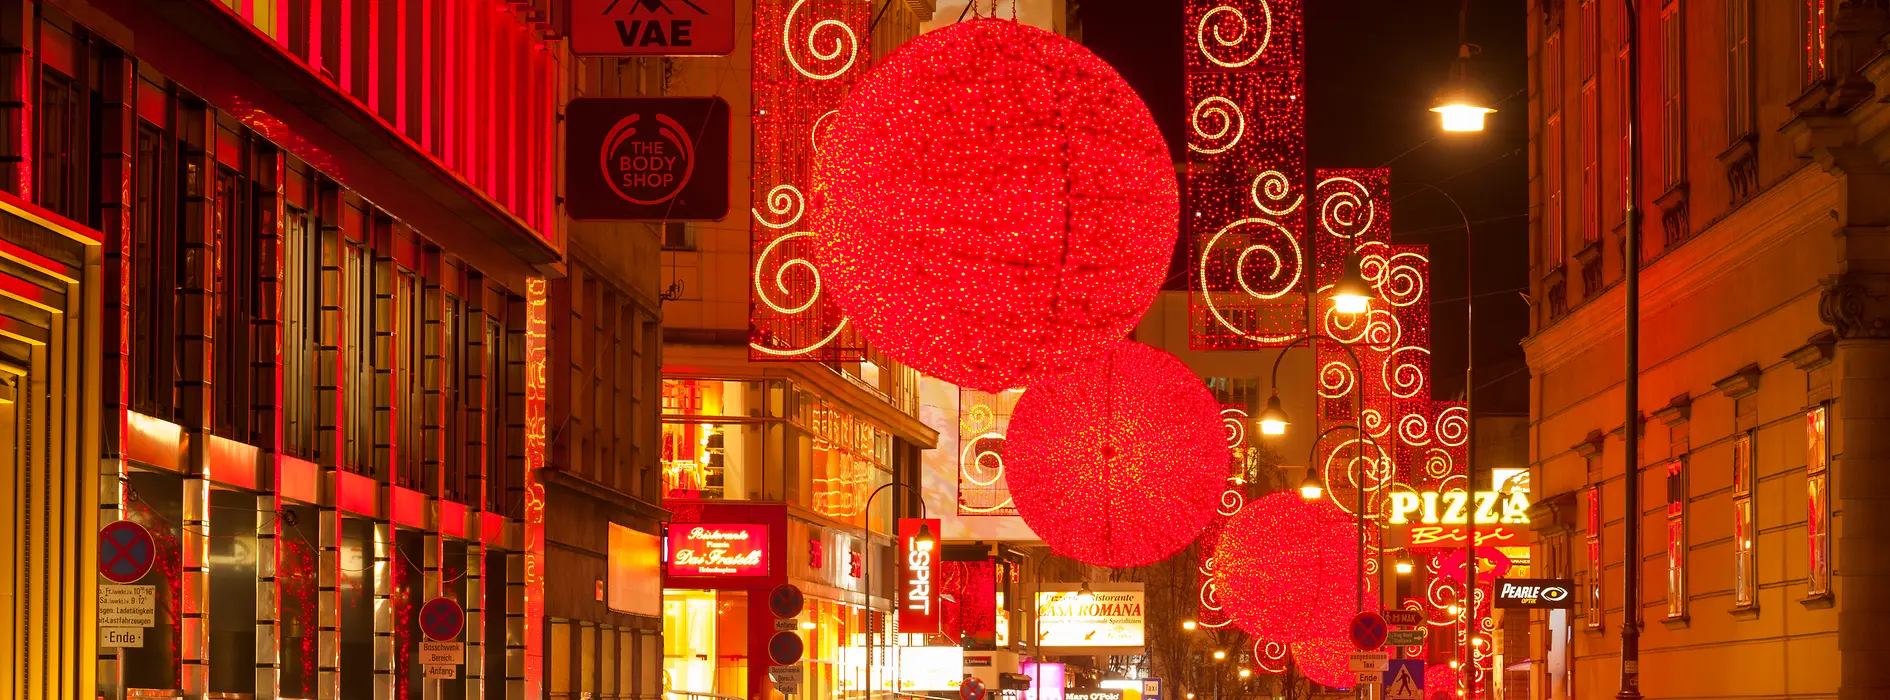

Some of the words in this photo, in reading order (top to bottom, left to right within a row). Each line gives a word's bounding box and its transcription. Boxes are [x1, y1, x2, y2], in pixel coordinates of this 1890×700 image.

[615, 20, 692, 47] VAE
[631, 141, 663, 154] THE
[620, 157, 676, 171] BODY
[623, 173, 673, 188] SHOP
[1388, 491, 1530, 524] PIZZA
[687, 526, 749, 540] Ristorante
[674, 549, 704, 565] Dai
[704, 549, 762, 565] Fratelli
[1501, 583, 1540, 599] PEARLE
[1078, 603, 1142, 617] ROMANA
[109, 631, 136, 644] Ende
[430, 666, 453, 677] Anfang
[1362, 661, 1375, 669] Taxi
[1359, 673, 1378, 682] Ende
[1145, 683, 1158, 692] Taxi
[1065, 692, 1089, 700] Marc
